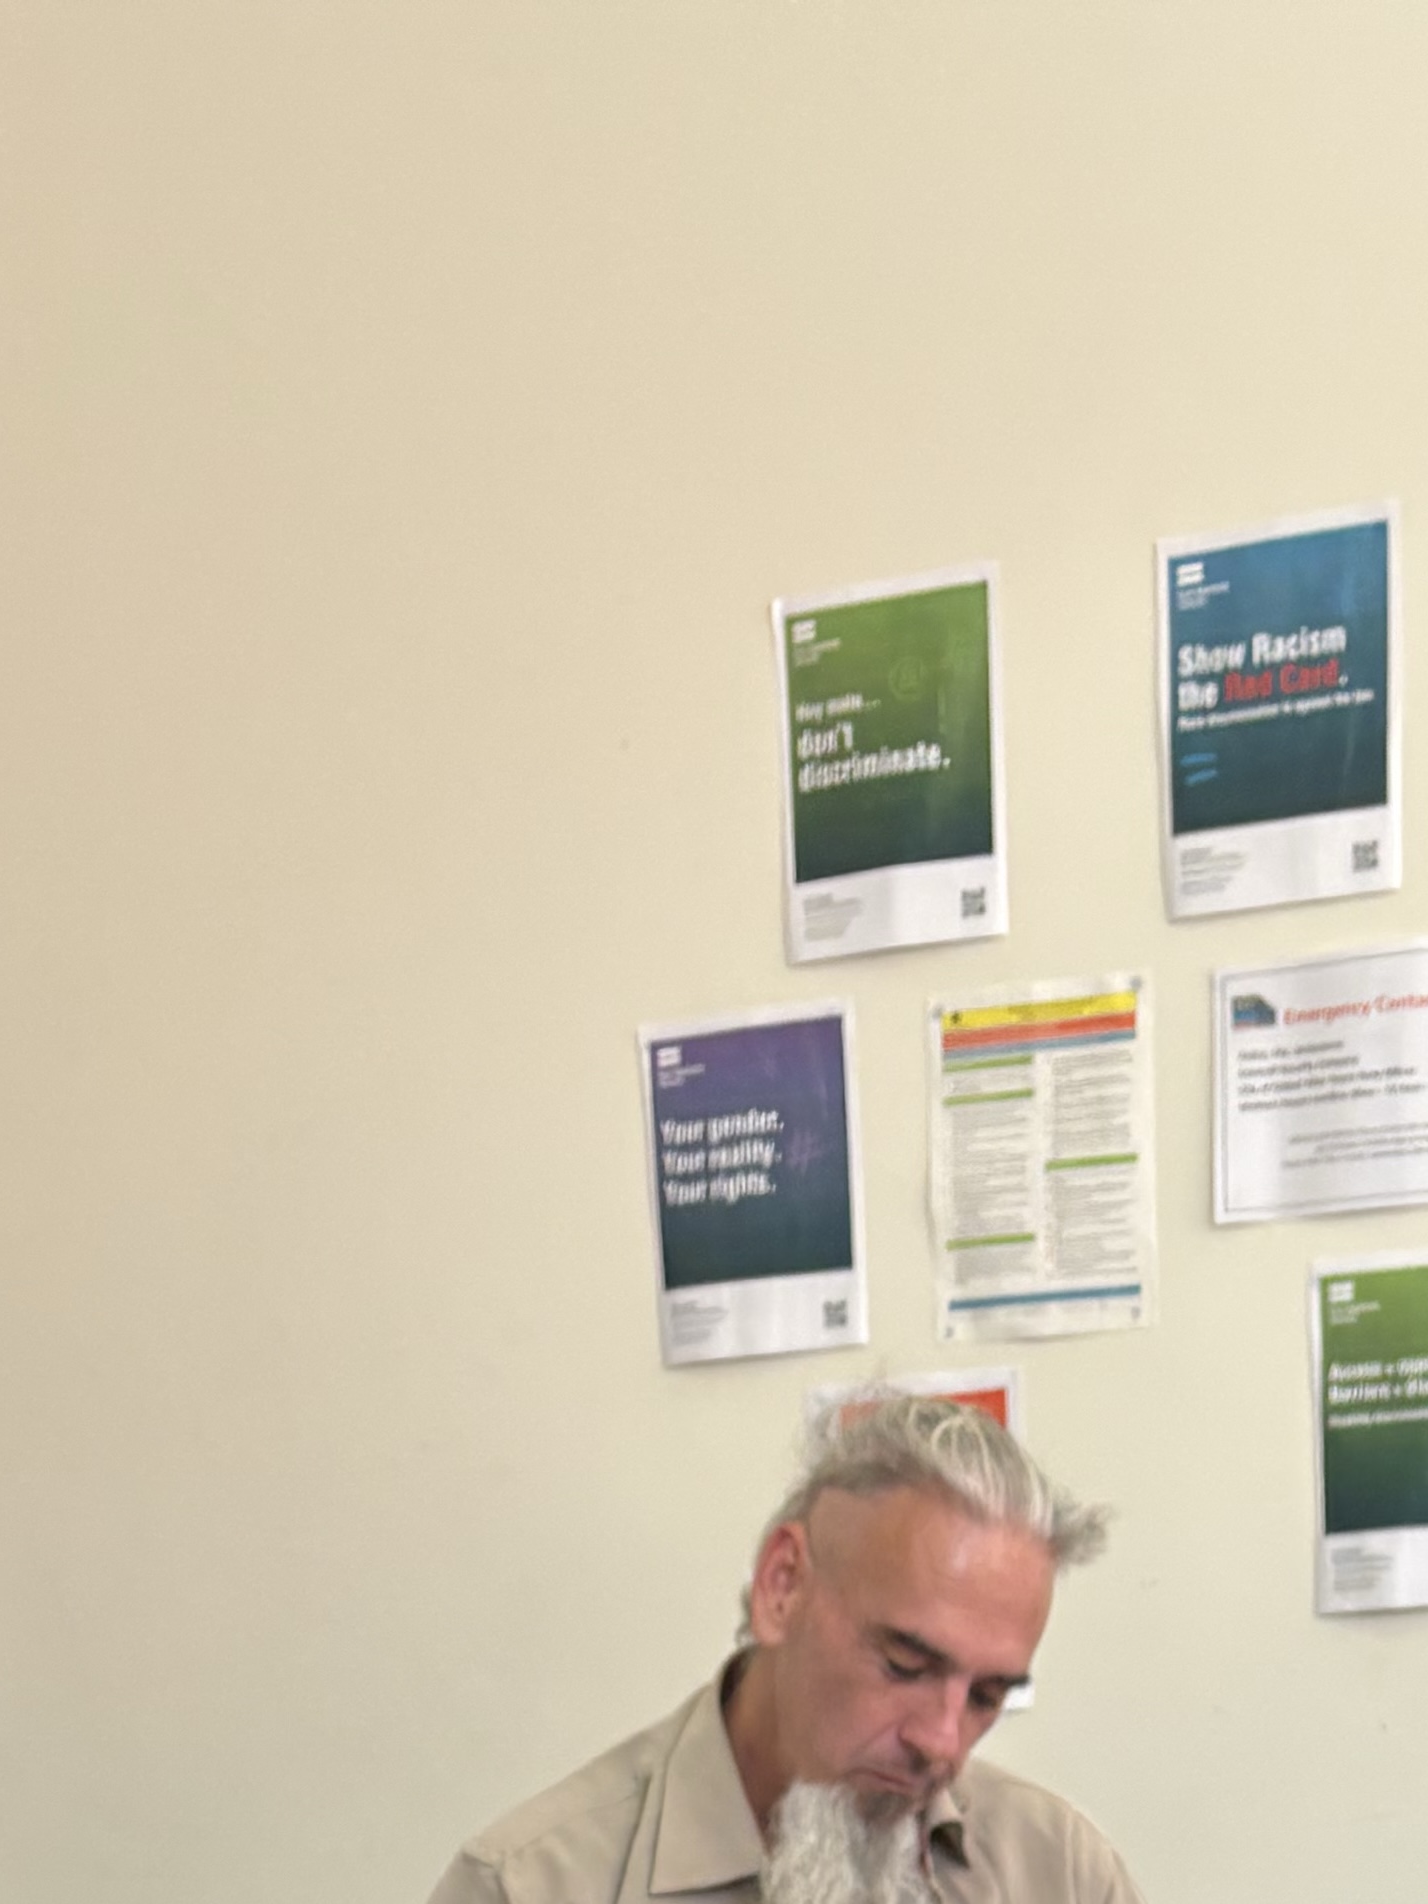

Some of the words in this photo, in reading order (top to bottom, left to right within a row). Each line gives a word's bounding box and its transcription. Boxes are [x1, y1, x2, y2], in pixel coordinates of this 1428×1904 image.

[1178, 642, 1246, 677] Show
[1252, 625, 1346, 667] Racism
[1178, 680, 1218, 711] the
[1224, 670, 1272, 702] Red
[1280, 657, 1349, 694] Card.
[797, 721, 853, 760] don't
[798, 741, 951, 793] discriminate.
[1283, 1000, 1373, 1029] Emergency
[660, 1118, 704, 1146] Your
[707, 1108, 784, 1142] gender.
[662, 1149, 706, 1176] Your
[663, 1180, 707, 1206] Your
